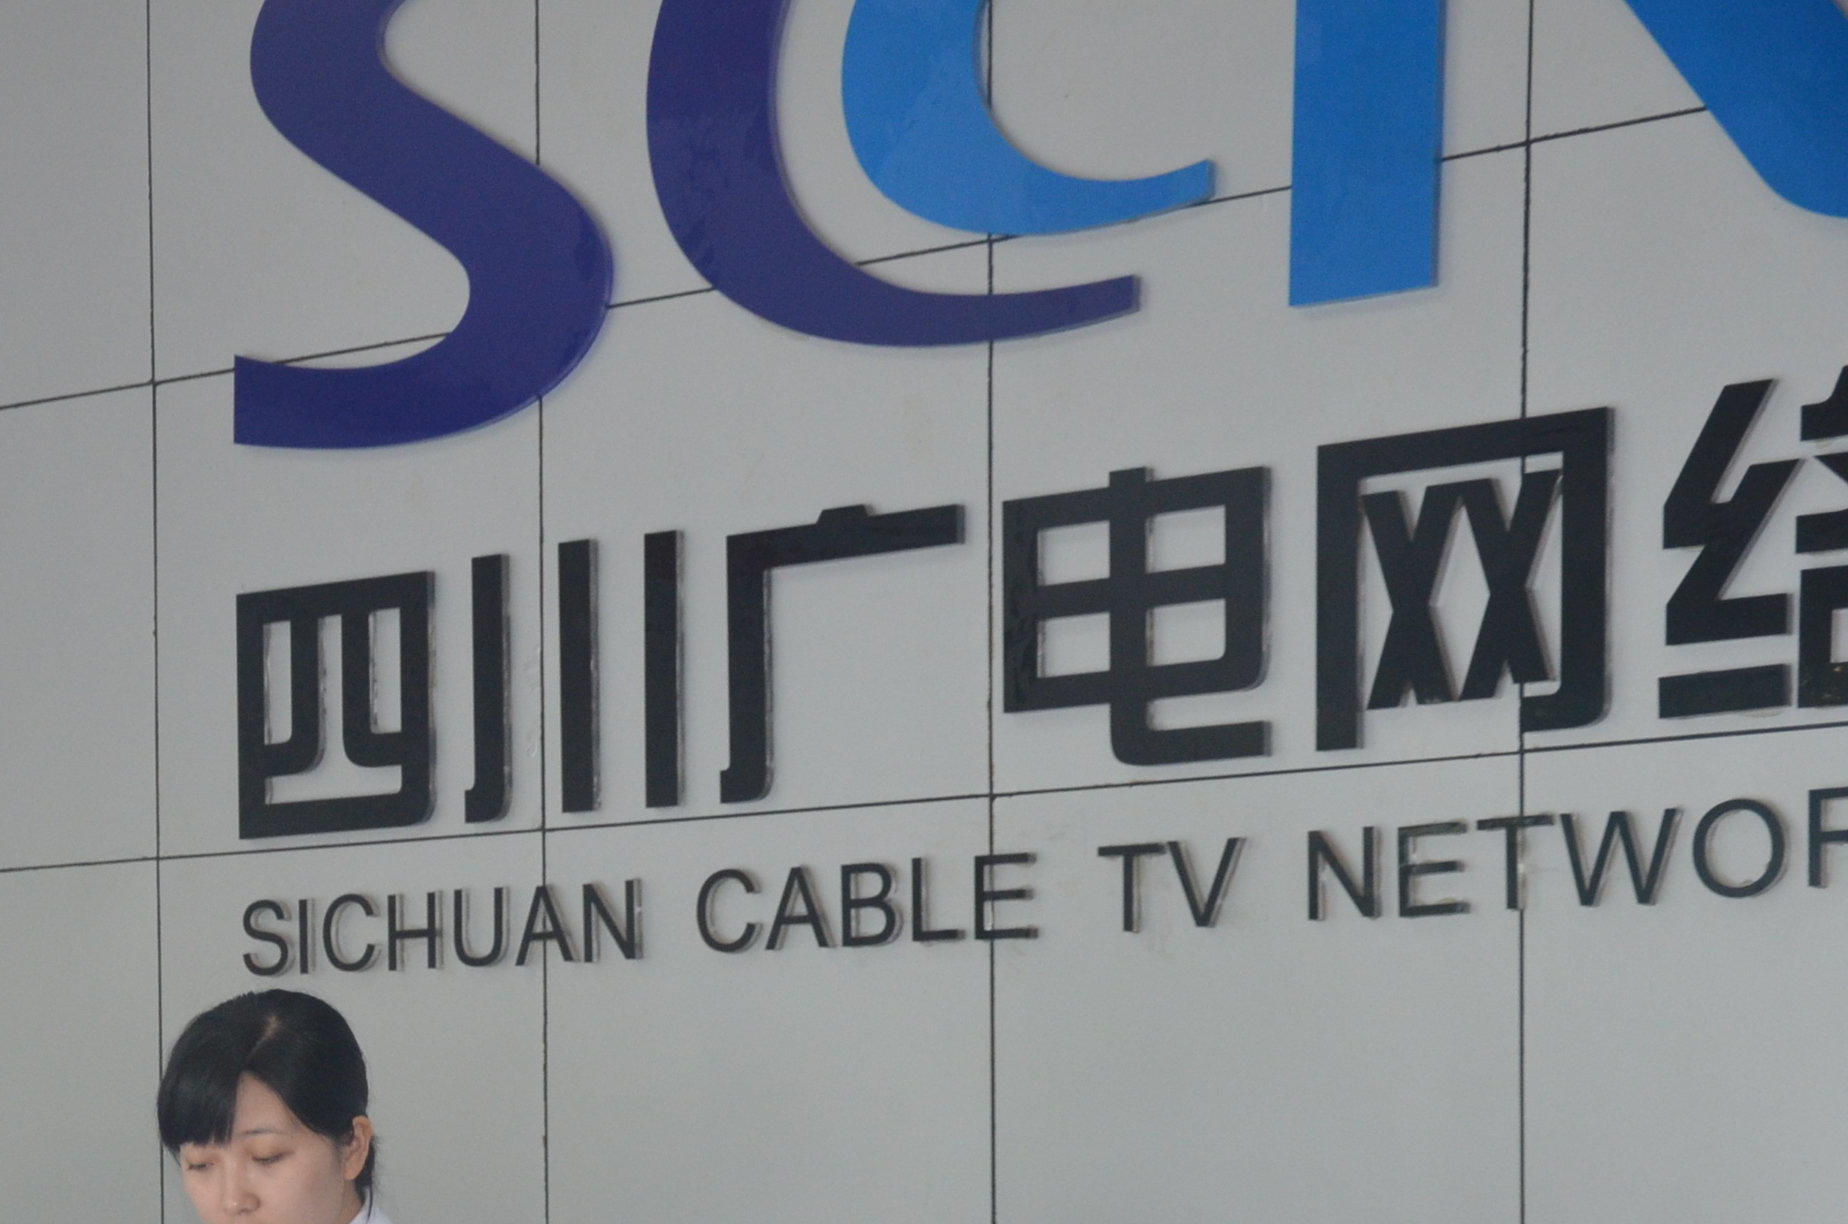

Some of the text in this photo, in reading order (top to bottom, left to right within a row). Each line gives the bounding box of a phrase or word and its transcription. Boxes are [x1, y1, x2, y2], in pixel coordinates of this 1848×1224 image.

[236, 363, 1848, 841] 四川广电网络
[242, 876, 643, 977] SICHUAN
[696, 852, 1039, 953] CABLE
[1097, 836, 1247, 933] TV
